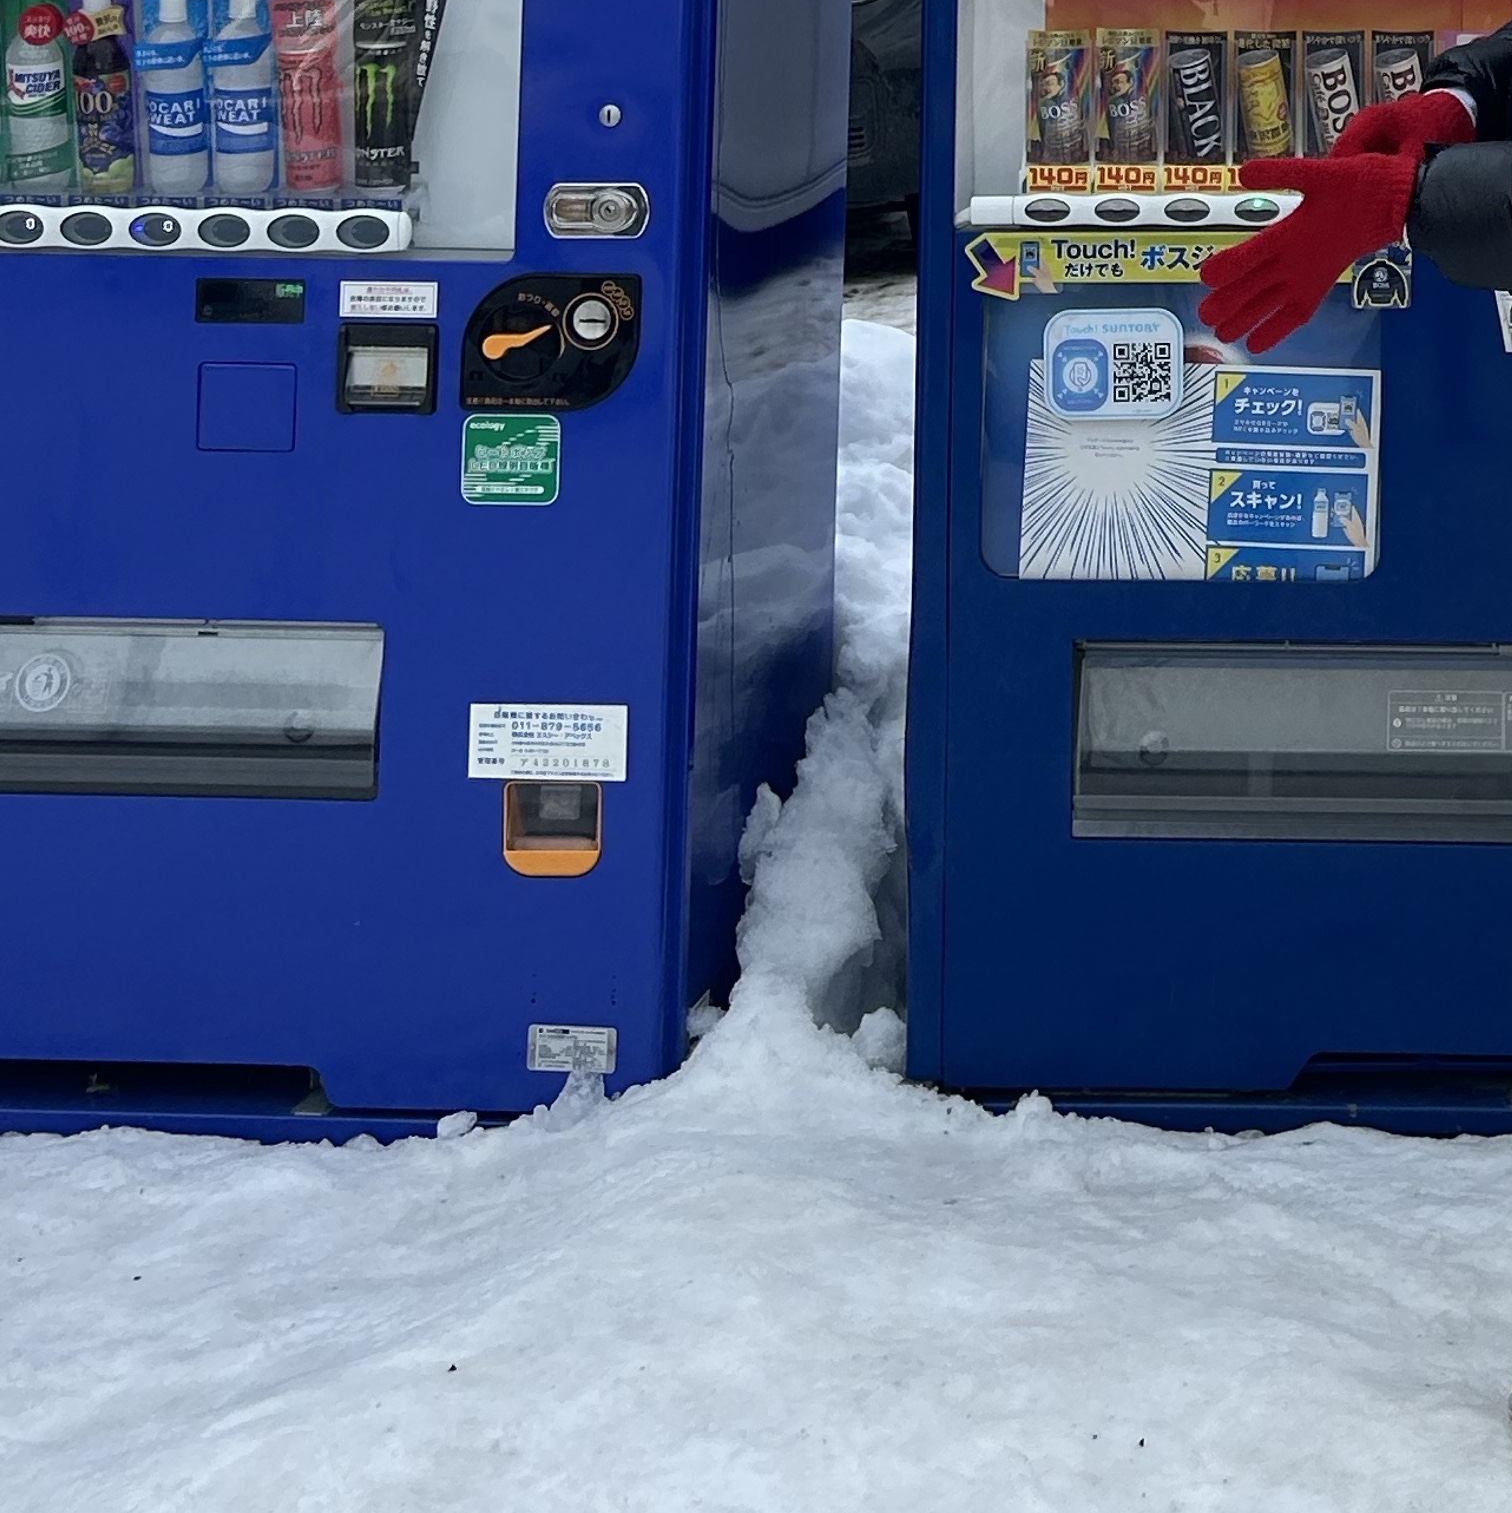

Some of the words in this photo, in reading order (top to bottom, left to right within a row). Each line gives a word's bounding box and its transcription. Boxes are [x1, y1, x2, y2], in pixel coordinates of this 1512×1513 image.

[286, 9, 324, 29] 上陸
[15, 68, 61, 84] MITSUYA
[25, 80, 62, 94] CIDER
[1040, 98, 1079, 120] BOSS
[1109, 96, 1148, 119] BOSS
[1179, 64, 1223, 158] BLACK
[1028, 166, 1088, 184] 140円
[1097, 166, 1156, 184] 140円
[1163, 166, 1223, 184] 140円
[1051, 239, 1136, 260] Touch!
[1064, 263, 1124, 278] だけでも
[1064, 323, 1098, 336] Touch!
[1102, 323, 1160, 335] SUNTORY
[1224, 377, 1230, 389] 1
[1243, 386, 1300, 397] キャンペーンを
[1233, 397, 1303, 416] チェック!
[469, 421, 506, 432] ecology
[1218, 476, 1226, 487] 2
[1252, 480, 1277, 490] 買って
[1229, 491, 1303, 510] スキャン!
[511, 721, 603, 732] 011-879-5656
